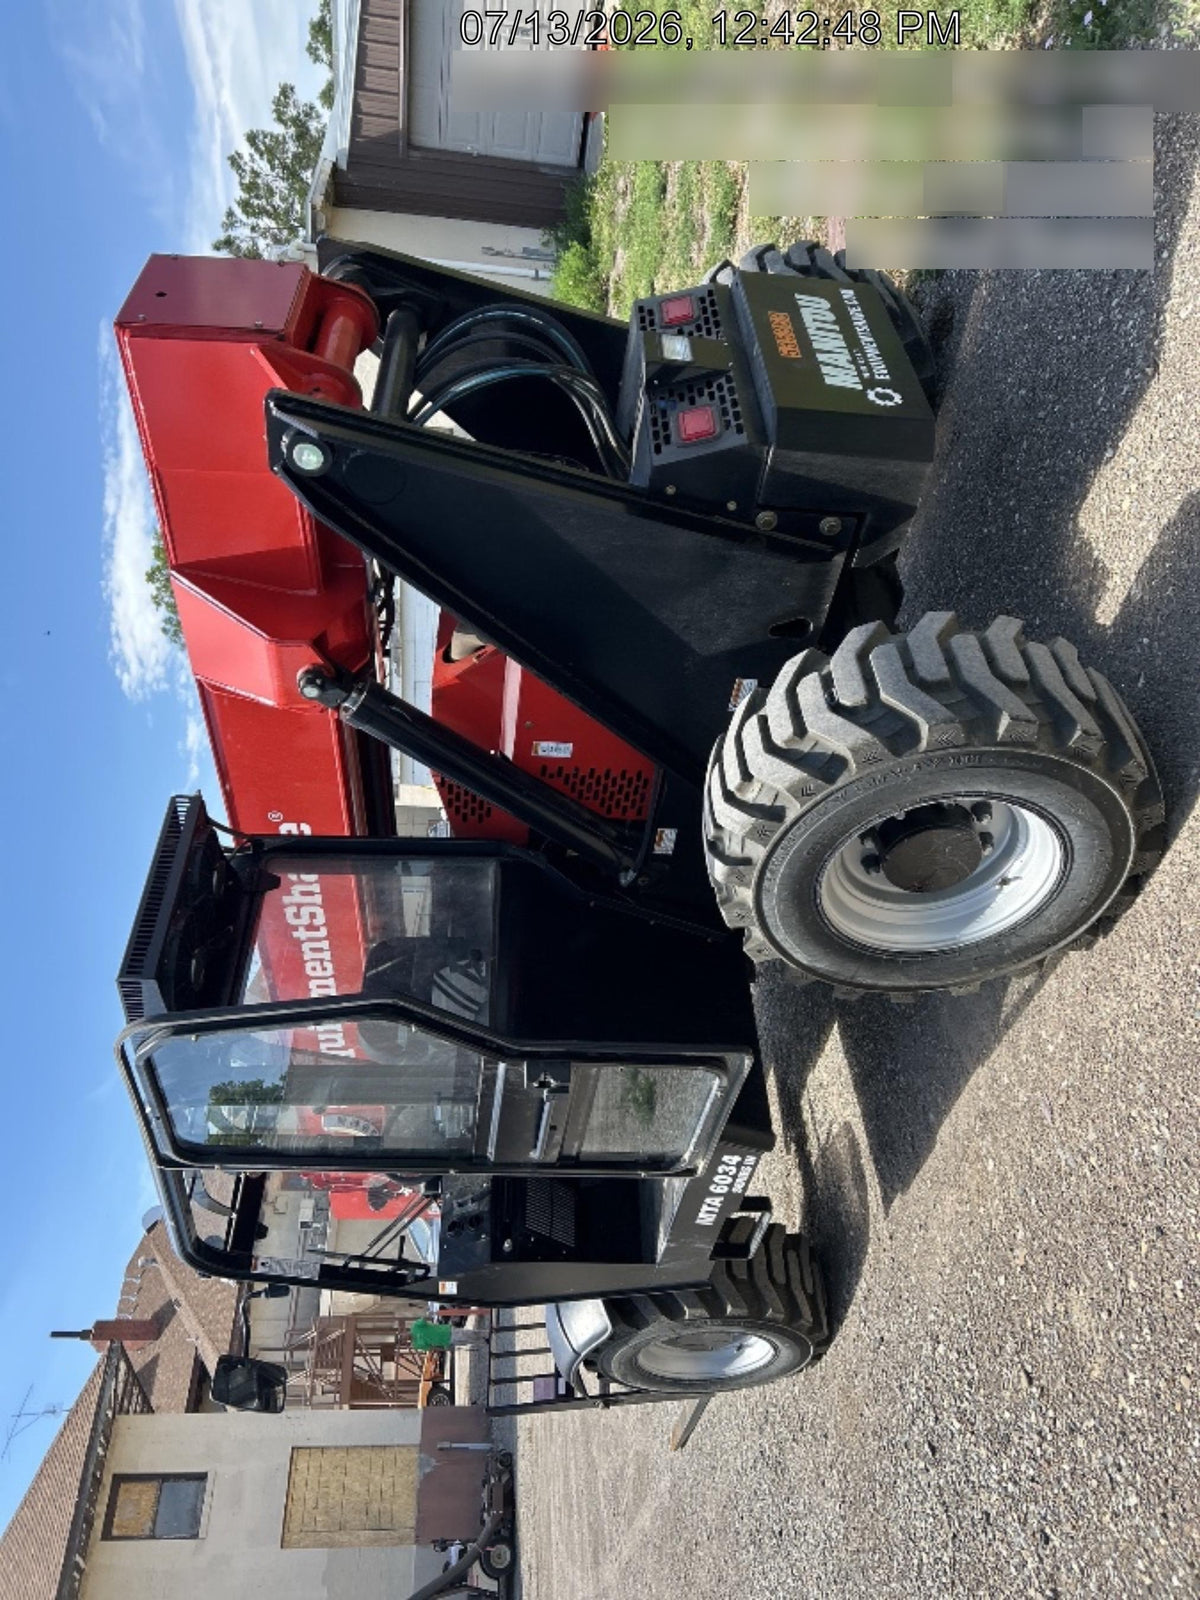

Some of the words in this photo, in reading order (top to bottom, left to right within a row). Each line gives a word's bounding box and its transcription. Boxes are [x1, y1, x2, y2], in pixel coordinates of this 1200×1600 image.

[795, 295, 863, 390] MANITOU
[709, 1155, 742, 1193] 6034
[695, 1197, 724, 1225] MTA
